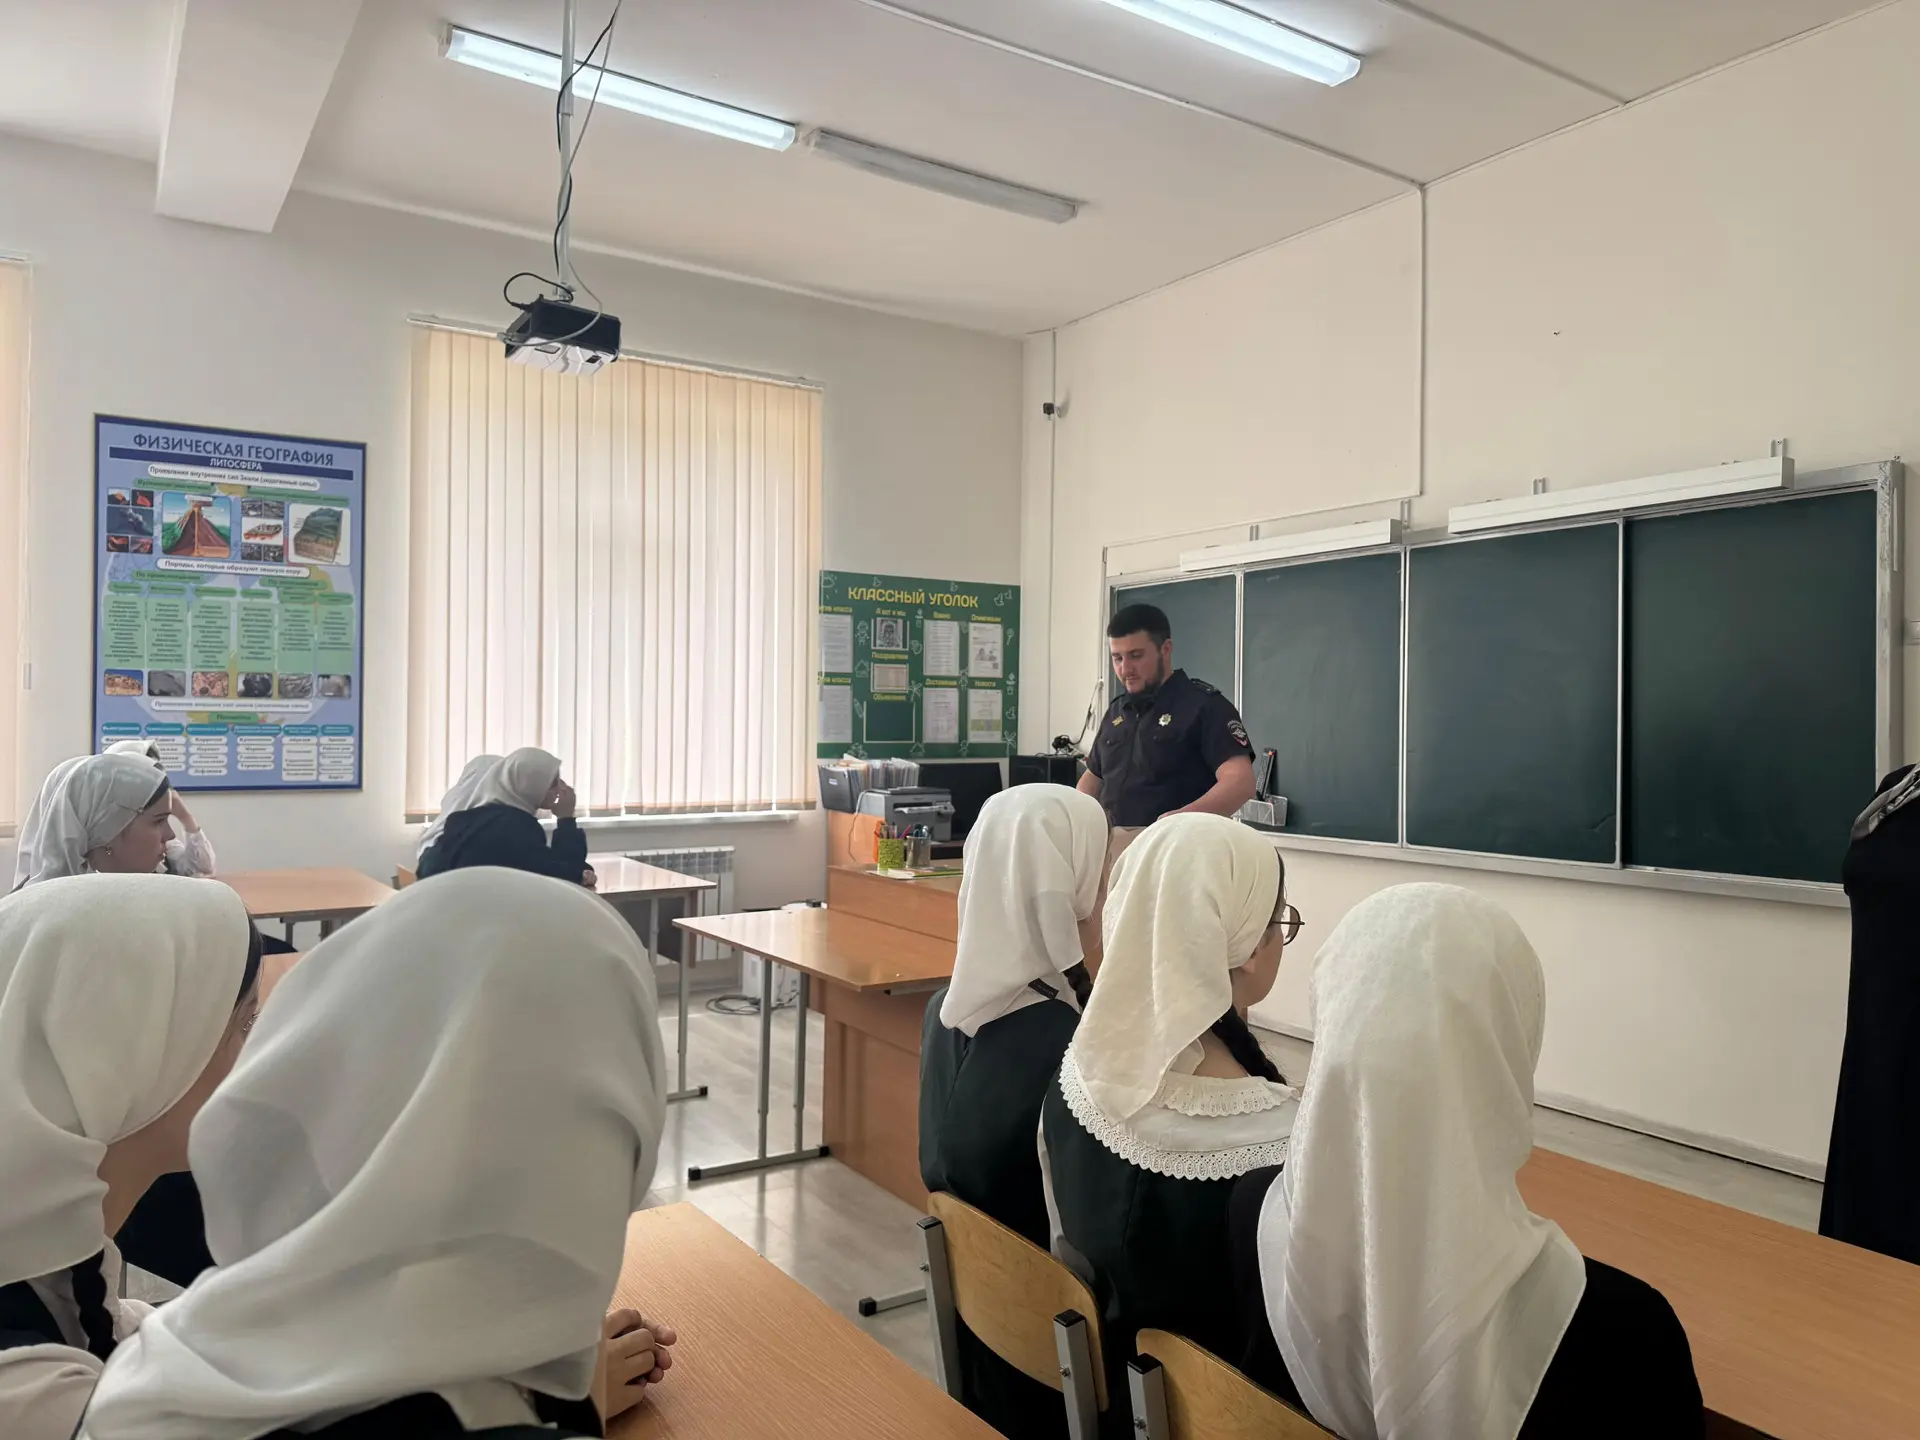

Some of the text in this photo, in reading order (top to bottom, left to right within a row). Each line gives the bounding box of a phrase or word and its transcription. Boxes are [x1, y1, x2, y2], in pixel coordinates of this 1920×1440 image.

[132, 433, 335, 467] ФИЗИЧЕСКАЯ ГЕОГРАФИЯ
[210, 458, 263, 471] ЛИТОСФЕРА
[847, 586, 979, 608] КЛАССНЫЙ УГОЛОК
